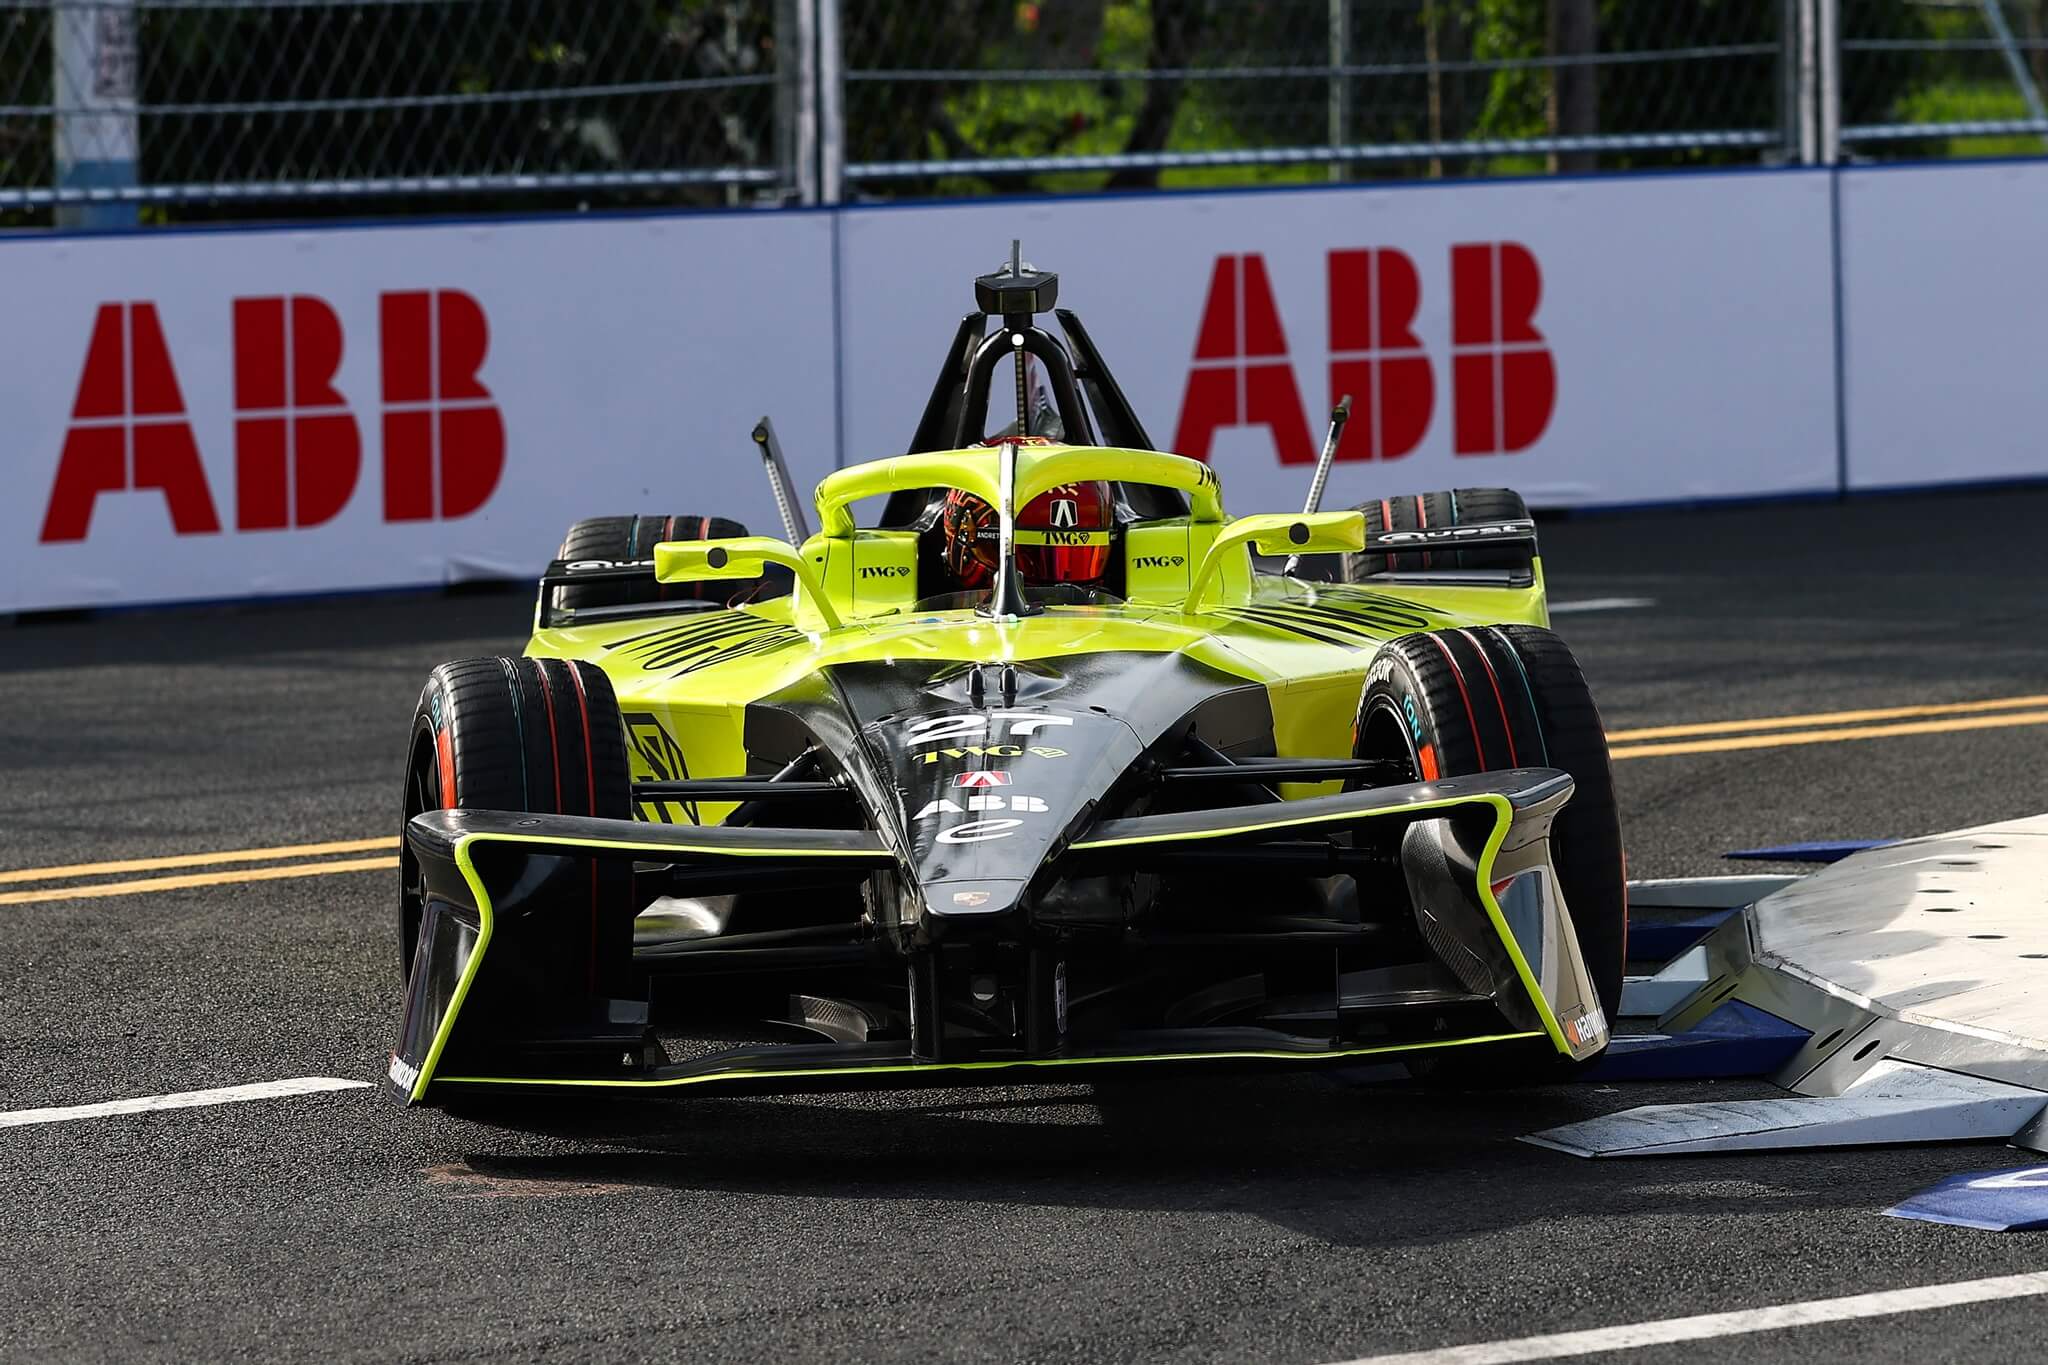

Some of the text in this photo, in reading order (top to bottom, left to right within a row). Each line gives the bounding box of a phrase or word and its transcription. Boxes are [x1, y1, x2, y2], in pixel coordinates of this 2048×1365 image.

[1172, 242, 1556, 466] ABB
[40, 289, 505, 543] ABB
[1041, 531, 1078, 545] TWG
[859, 566, 895, 580] TWG
[1132, 556, 1169, 569] TWG
[906, 712, 1074, 746] 27
[912, 745, 1024, 765] TWG
[912, 795, 1050, 821] ABB
